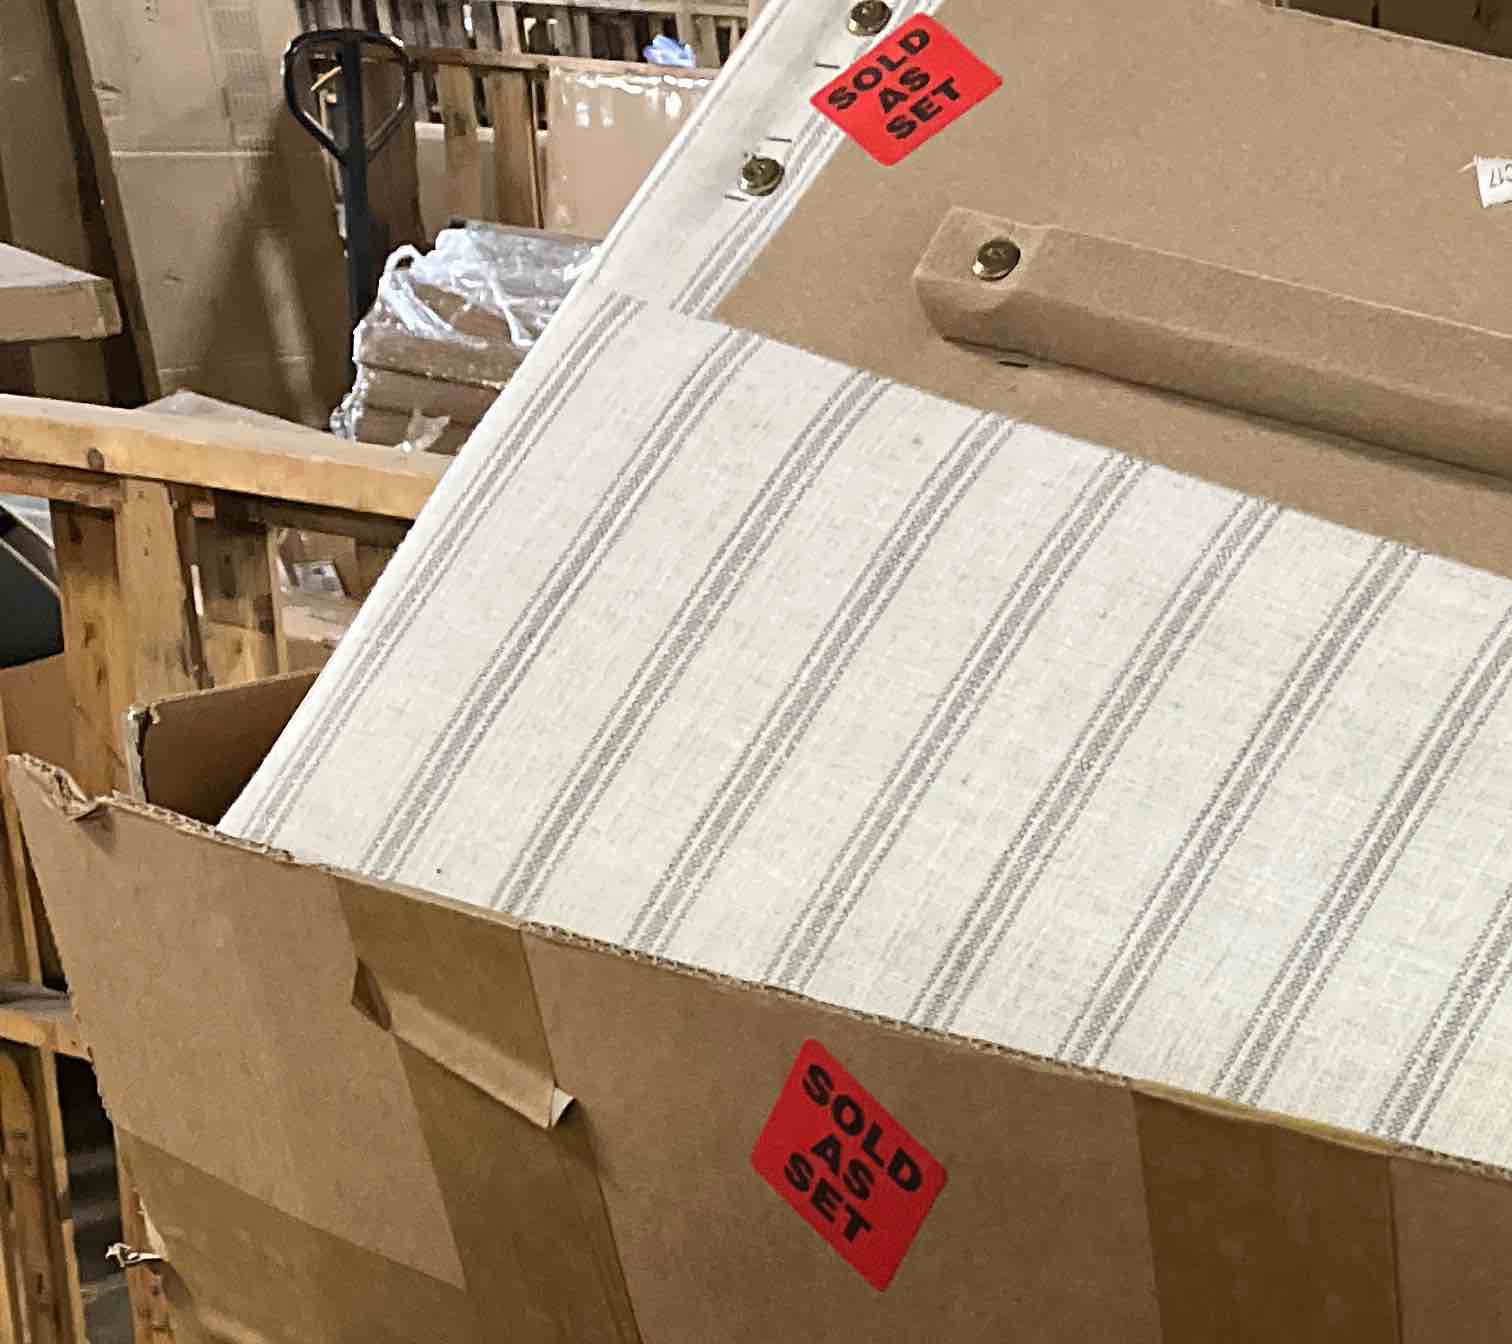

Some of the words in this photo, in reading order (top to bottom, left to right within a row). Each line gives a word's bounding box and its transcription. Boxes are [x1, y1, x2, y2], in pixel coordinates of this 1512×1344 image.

[828, 28, 930, 110] SOLD
[879, 67, 930, 113] AS
[886, 76, 960, 139] SET
[802, 1063, 923, 1192] SOLD
[784, 1152, 873, 1242] SET
[811, 1133, 875, 1201] AS
